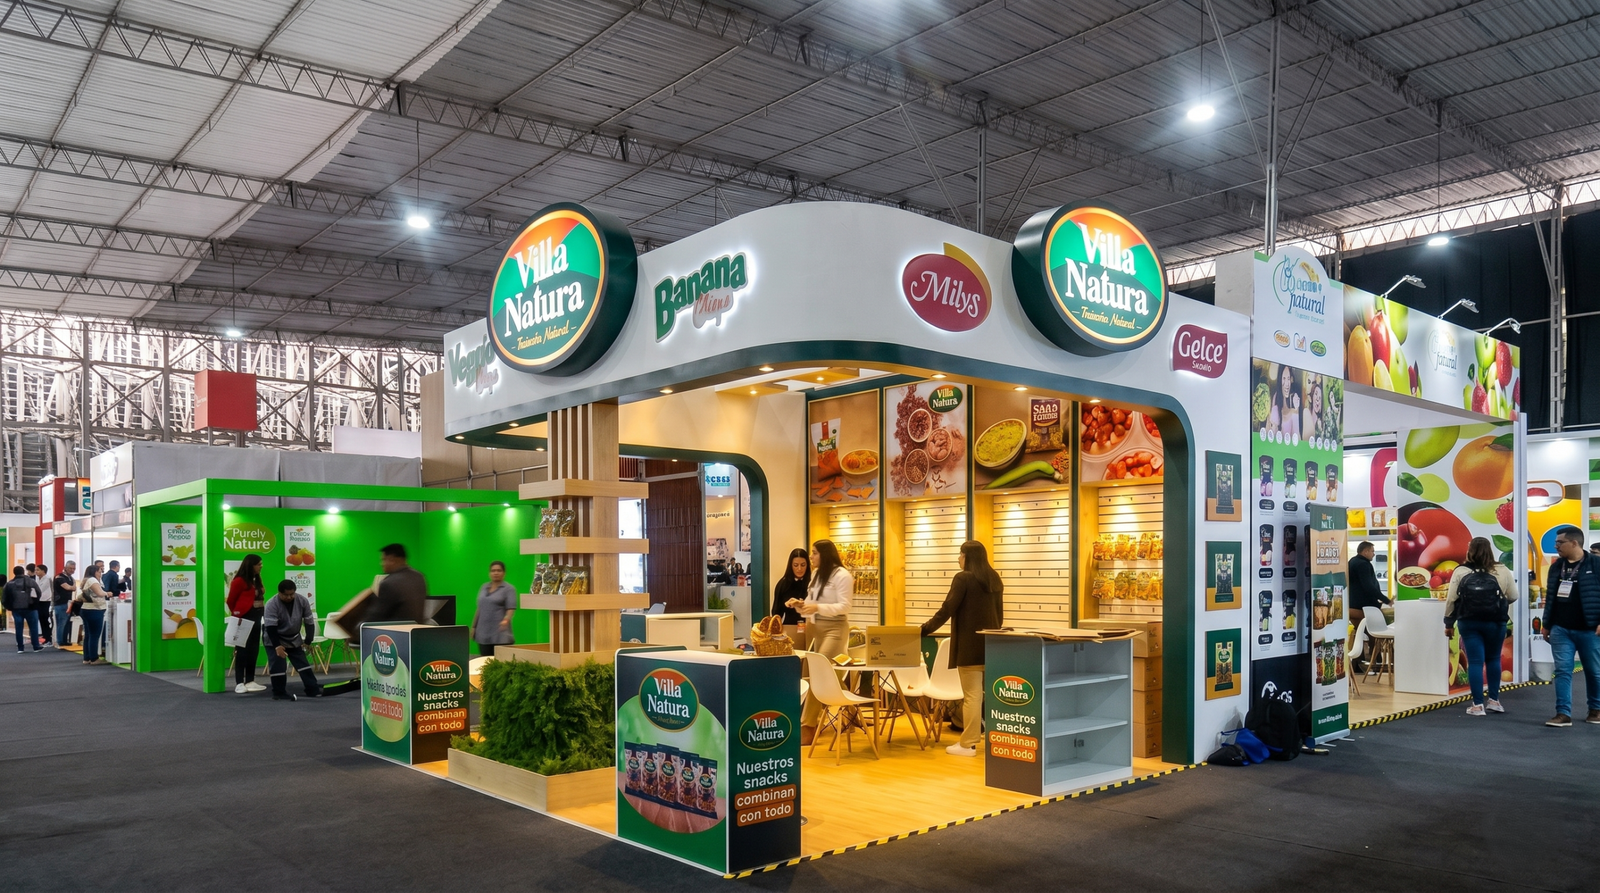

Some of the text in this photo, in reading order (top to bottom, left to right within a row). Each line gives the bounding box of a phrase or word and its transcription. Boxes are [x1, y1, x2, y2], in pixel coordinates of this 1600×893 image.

[1078, 222, 1136, 276] Villa
[514, 236, 569, 289] Villa
[911, 270, 980, 317] Milys
[1065, 257, 1149, 316] Natura
[655, 254, 746, 341] Banana
[504, 281, 584, 337] Natura
[1178, 331, 1223, 364] Gelce
[937, 388, 953, 398] Villa
[232, 528, 266, 540] Purely
[224, 537, 271, 550] Nature
[377, 640, 390, 654] Villa
[374, 652, 394, 667] Natura
[430, 664, 450, 673] Villa
[425, 672, 456, 680] Natura
[654, 677, 682, 698] Villa
[1004, 680, 1023, 690] Villa
[417, 690, 464, 701] Nuestros
[998, 687, 1028, 700] Natura
[423, 700, 459, 710] snacks
[647, 694, 690, 718] Natura
[417, 711, 465, 721] combinan
[991, 709, 1036, 725] Nuestros
[419, 720, 462, 733] con todo
[753, 717, 777, 730] Villa
[996, 722, 1031, 735] snacks
[747, 729, 784, 743] Natura
[990, 734, 1036, 748] combinan
[993, 747, 1033, 760] con todo
[736, 757, 794, 776] Nuestros
[744, 771, 788, 789] snacks
[736, 788, 795, 807] combinan
[740, 803, 791, 823] con todo
